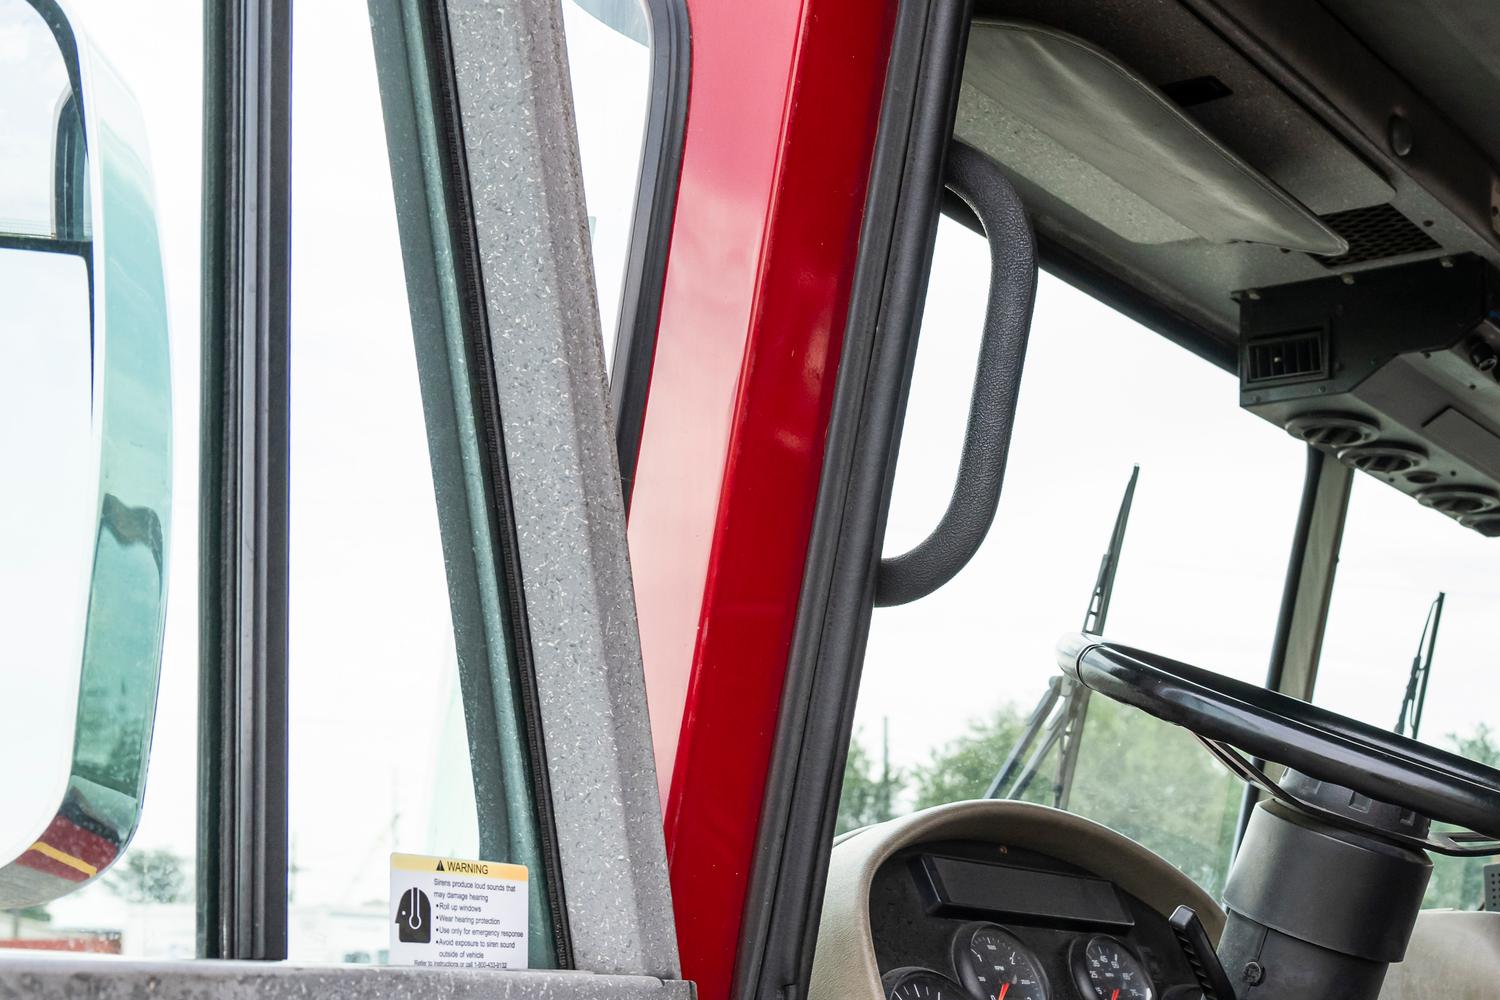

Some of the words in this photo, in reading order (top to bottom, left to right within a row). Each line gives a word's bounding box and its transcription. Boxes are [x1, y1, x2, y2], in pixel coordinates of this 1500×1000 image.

[447, 860, 488, 874] WARNING
[434, 878, 451, 886] Sirens
[452, 880, 473, 888] produce
[474, 882, 486, 890] loud
[487, 884, 504, 892] sounds
[506, 884, 516, 892] that
[447, 892, 468, 902] damage
[469, 894, 488, 903] hearing
[440, 902, 450, 910] Roll
[459, 904, 482, 912] windows
[439, 914, 454, 922] Wear
[454, 916, 474, 925] hearing
[451, 928, 462, 936] only
[472, 930, 500, 938] emergency
[500, 930, 524, 938] response
[439, 938, 454, 946] Avoid
[455, 940, 478, 948] exposure
[434, 960, 459, 968] instructions
[1090, 970, 1098, 979] 25
